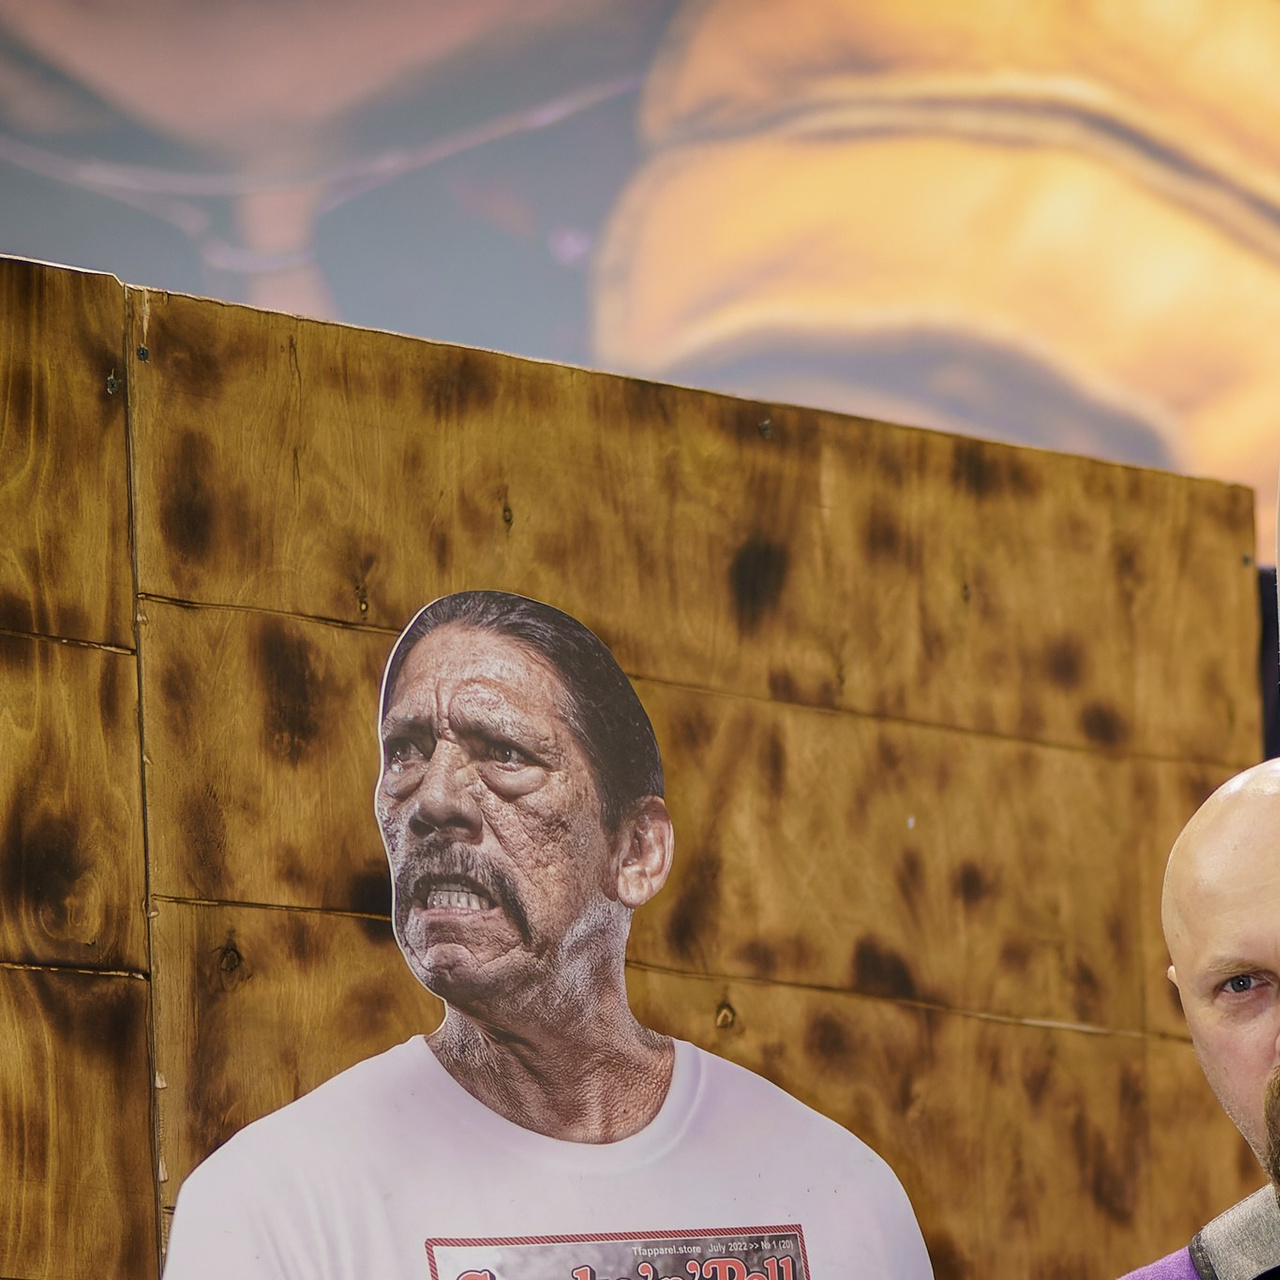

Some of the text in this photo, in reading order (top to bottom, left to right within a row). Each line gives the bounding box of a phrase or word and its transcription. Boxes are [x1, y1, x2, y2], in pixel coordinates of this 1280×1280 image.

[708, 1243, 726, 1253] July
[729, 1242, 747, 1251] 2022
[779, 1240, 793, 1250] (20)
